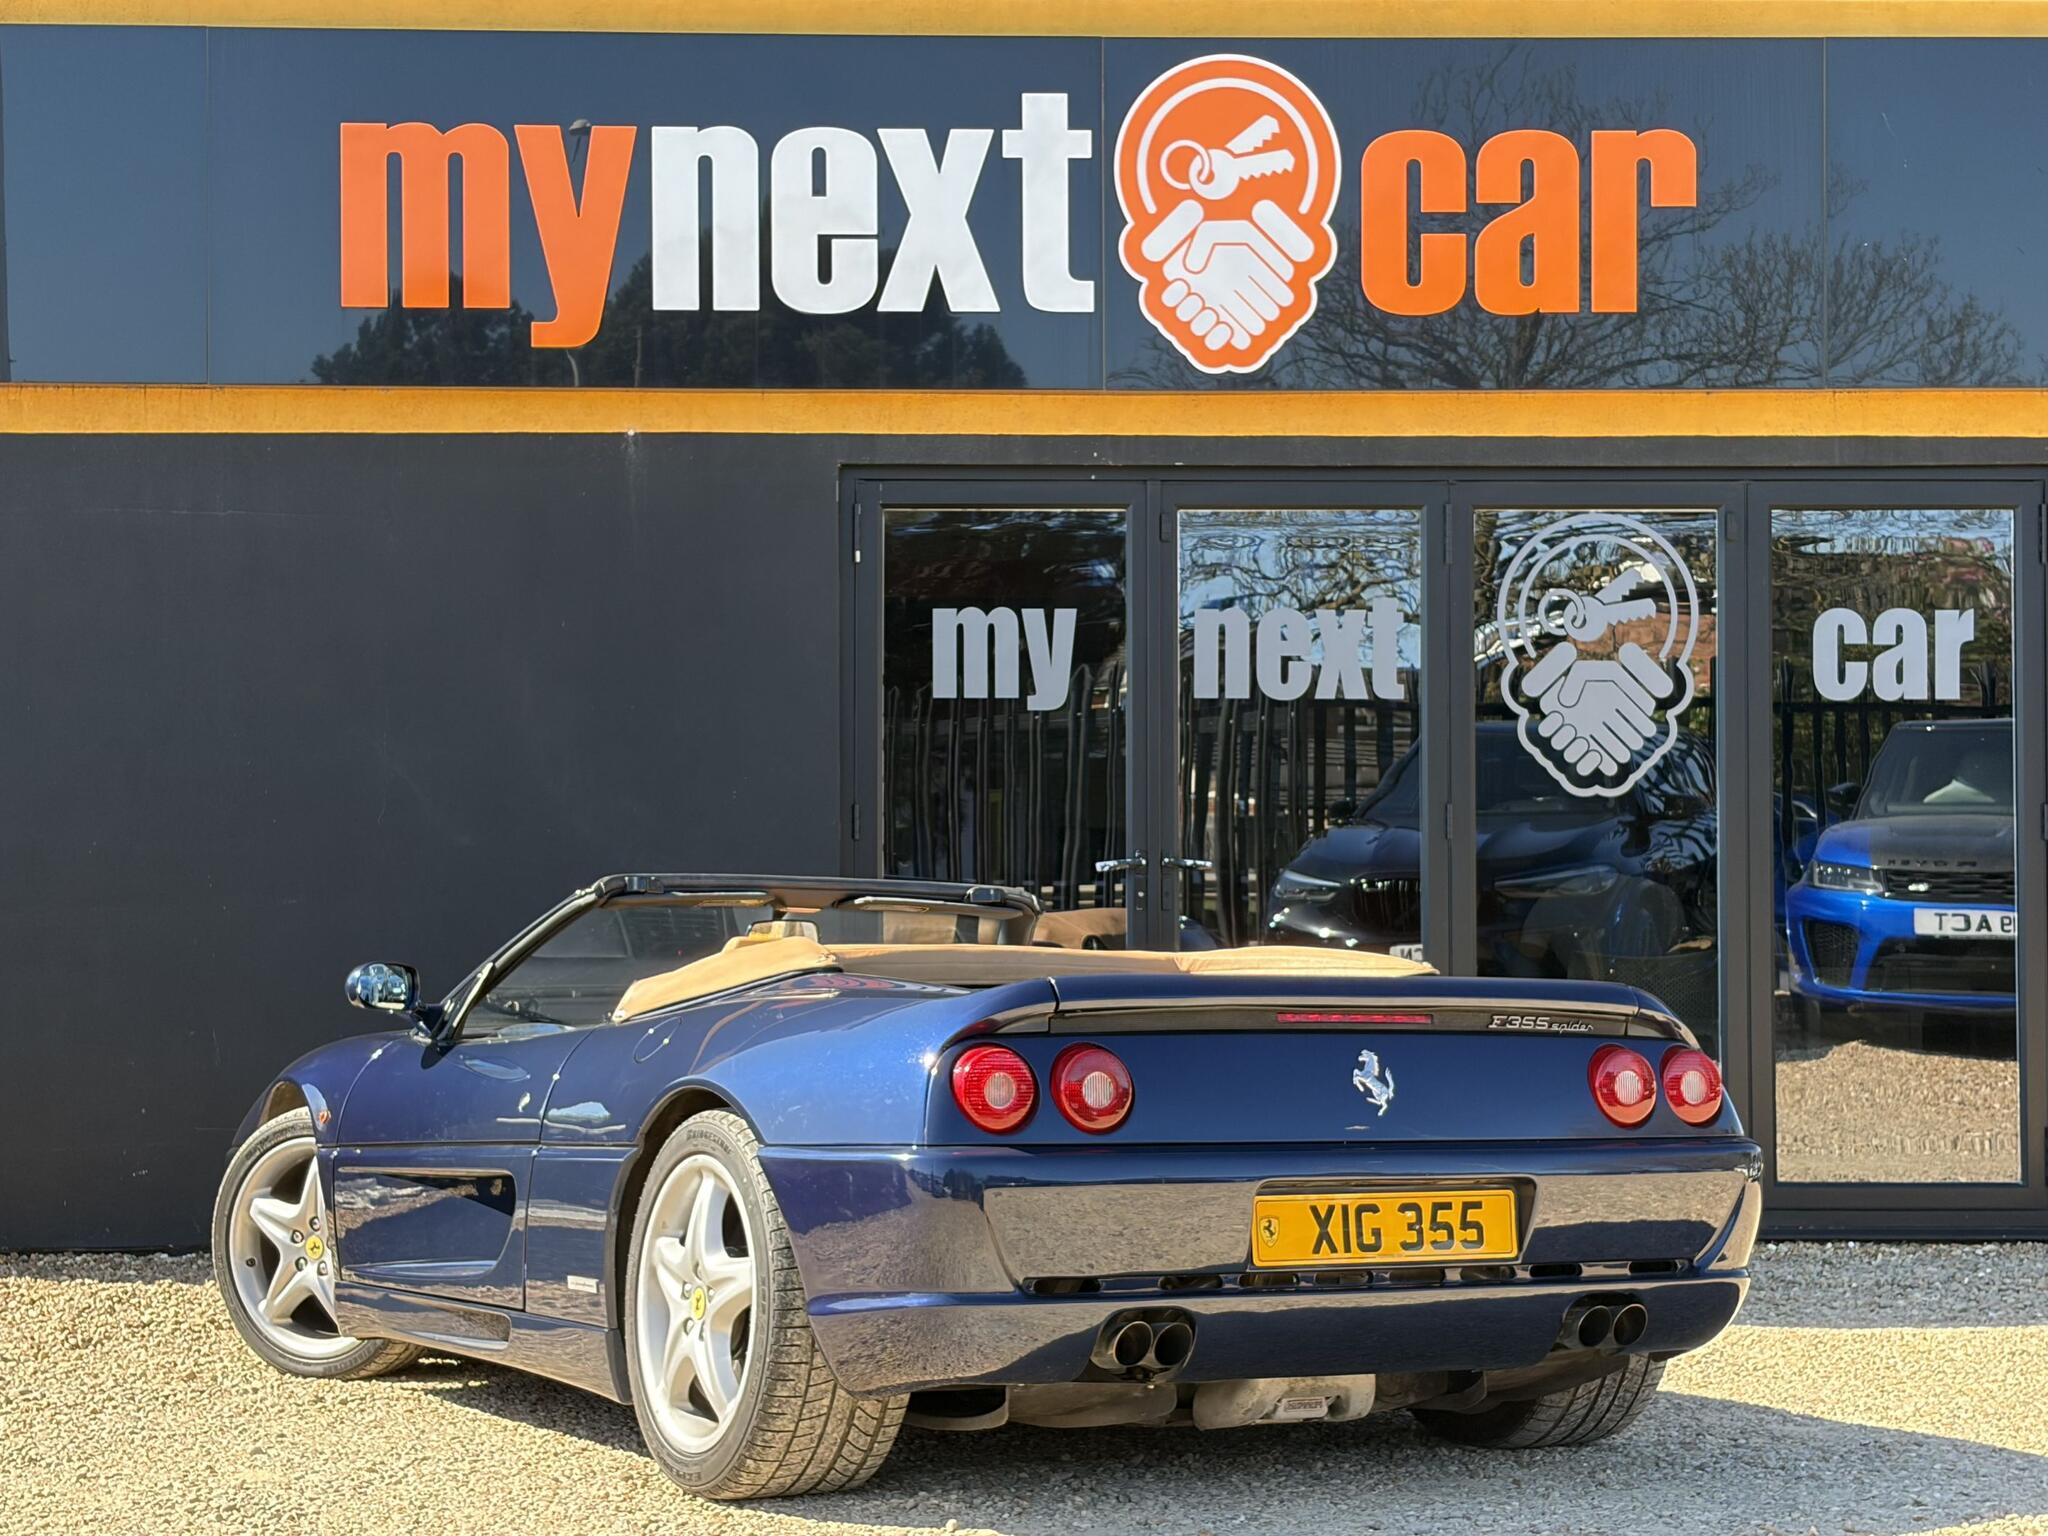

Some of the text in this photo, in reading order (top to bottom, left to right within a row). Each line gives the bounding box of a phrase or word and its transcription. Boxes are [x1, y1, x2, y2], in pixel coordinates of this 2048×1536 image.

[1361, 129, 1697, 316] car
[932, 599, 1975, 711] my next car
[1488, 1015, 1551, 1030] F355
[1309, 1200, 1485, 1255] XIG 355
